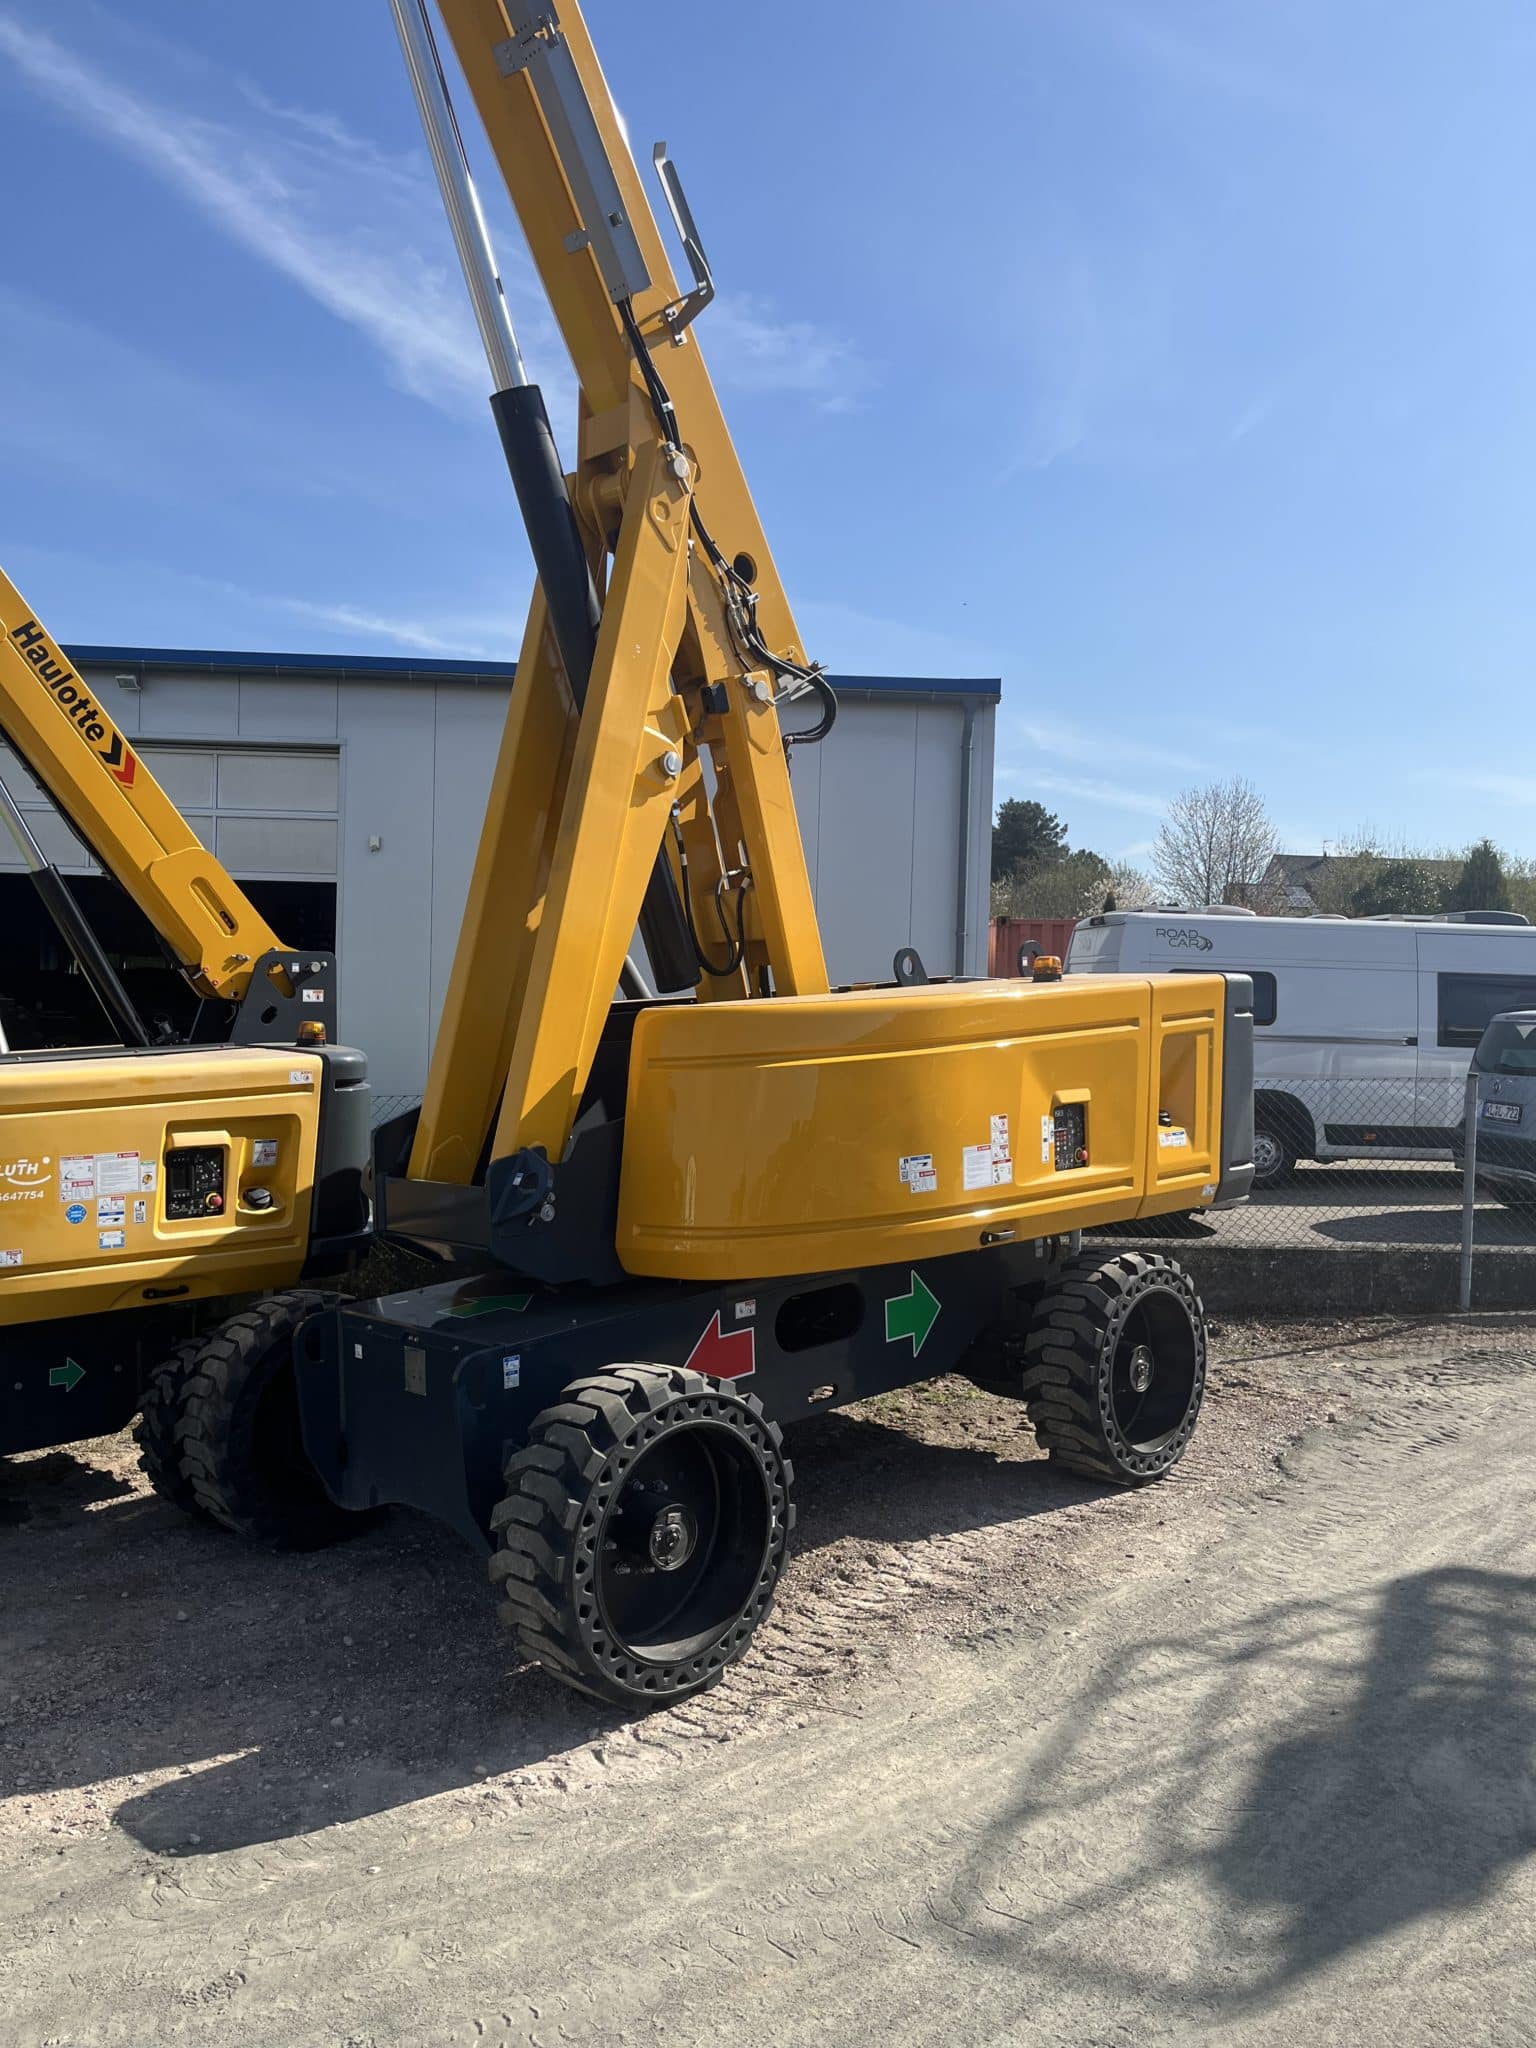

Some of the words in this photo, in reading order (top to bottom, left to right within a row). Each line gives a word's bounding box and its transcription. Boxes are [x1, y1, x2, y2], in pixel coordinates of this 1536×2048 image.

[11, 619, 105, 742] Haulotte
[1155, 928, 1199, 939] ROAD
[1168, 938, 1201, 949] CAR
